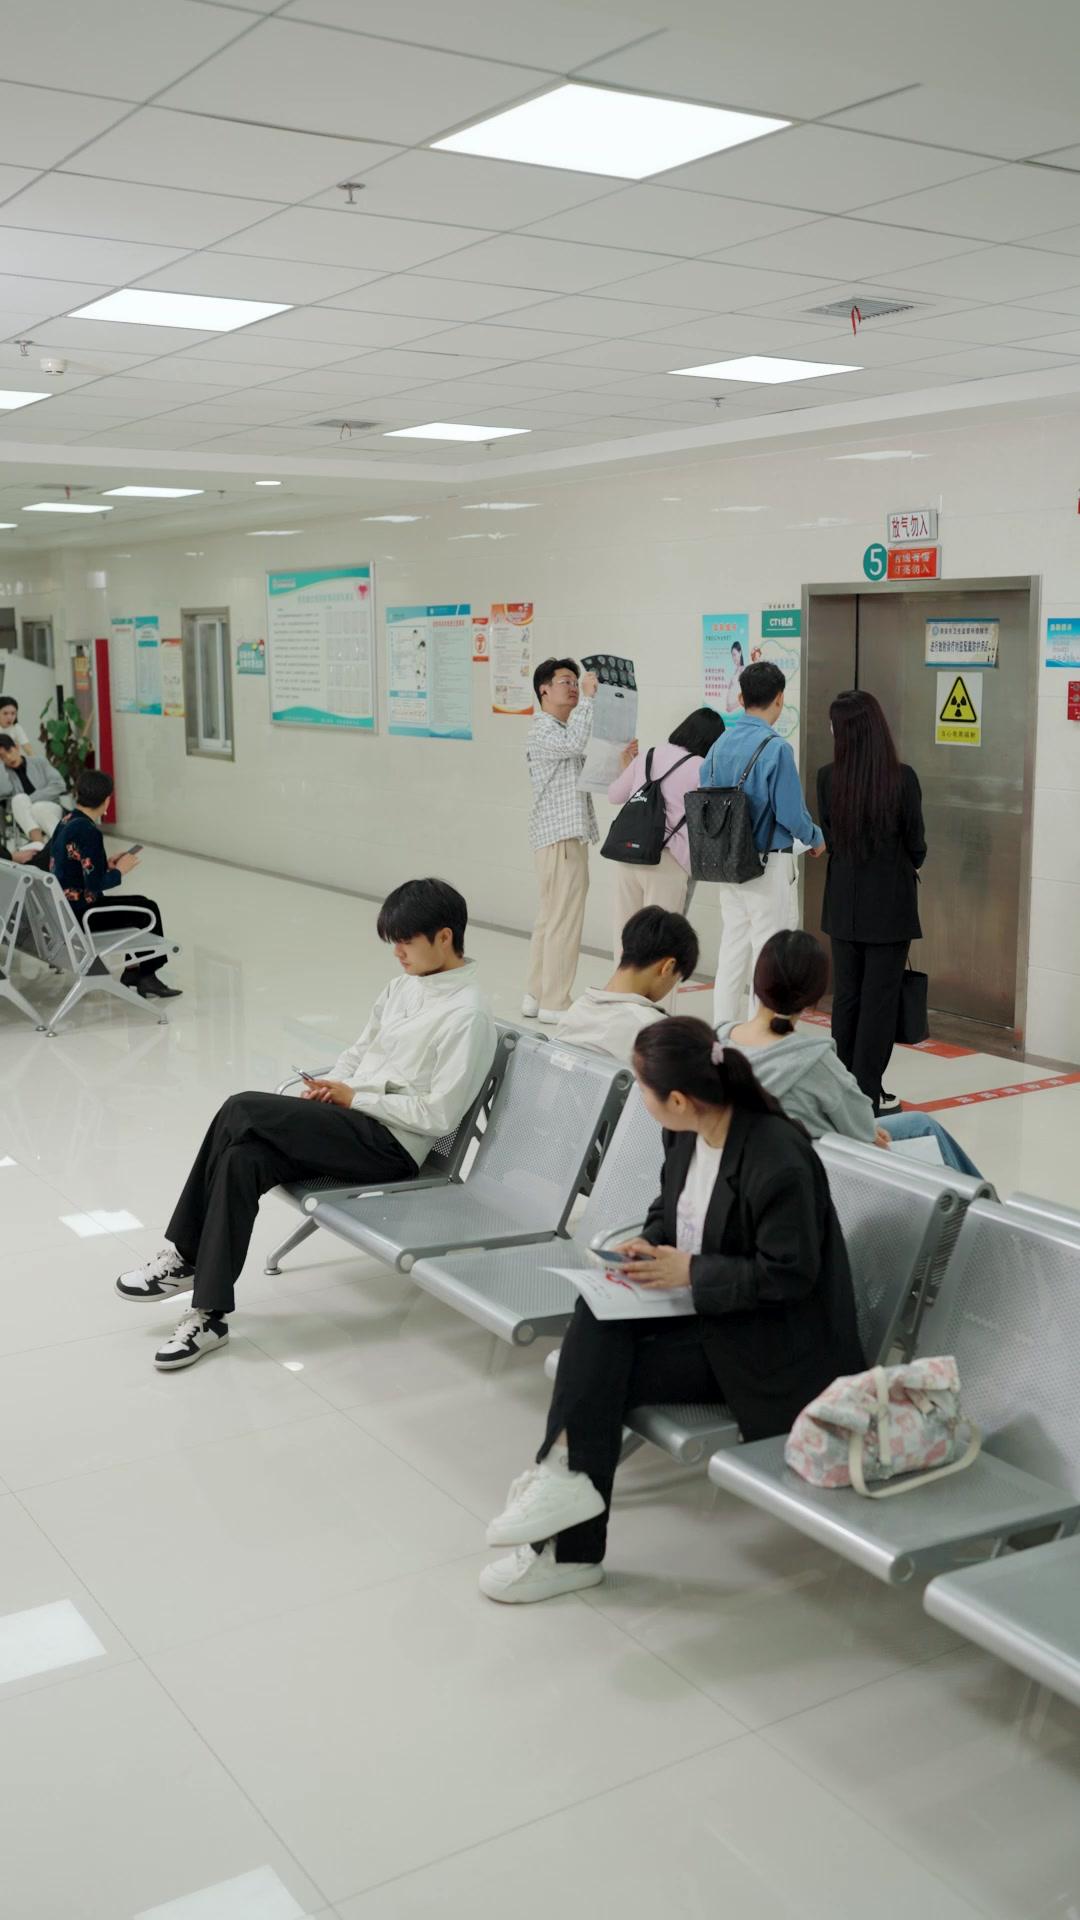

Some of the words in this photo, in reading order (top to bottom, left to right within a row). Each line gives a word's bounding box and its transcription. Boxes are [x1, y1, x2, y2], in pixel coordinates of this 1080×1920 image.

[891, 514, 928, 538] 放气勿入
[869, 548, 883, 576] 5
